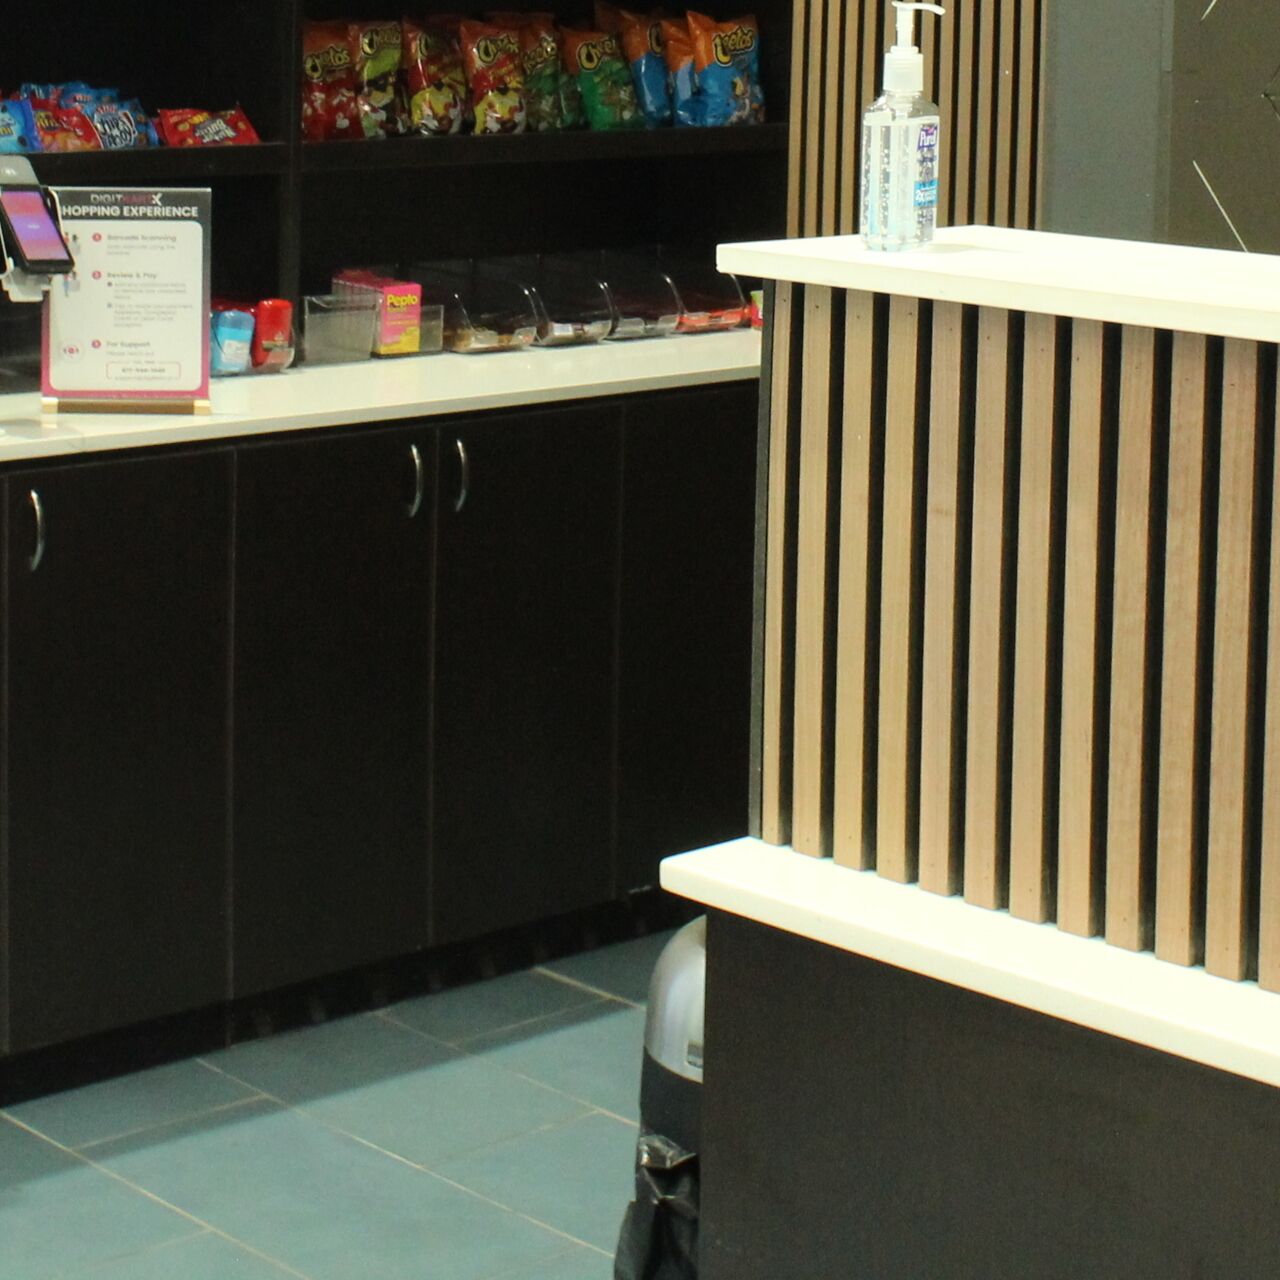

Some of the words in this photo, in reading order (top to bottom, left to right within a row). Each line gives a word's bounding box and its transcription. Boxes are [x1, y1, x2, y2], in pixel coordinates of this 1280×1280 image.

[62, 206, 120, 217] HOPPING
[123, 206, 199, 217] EXPERIENCE
[386, 294, 418, 310] Pepto
